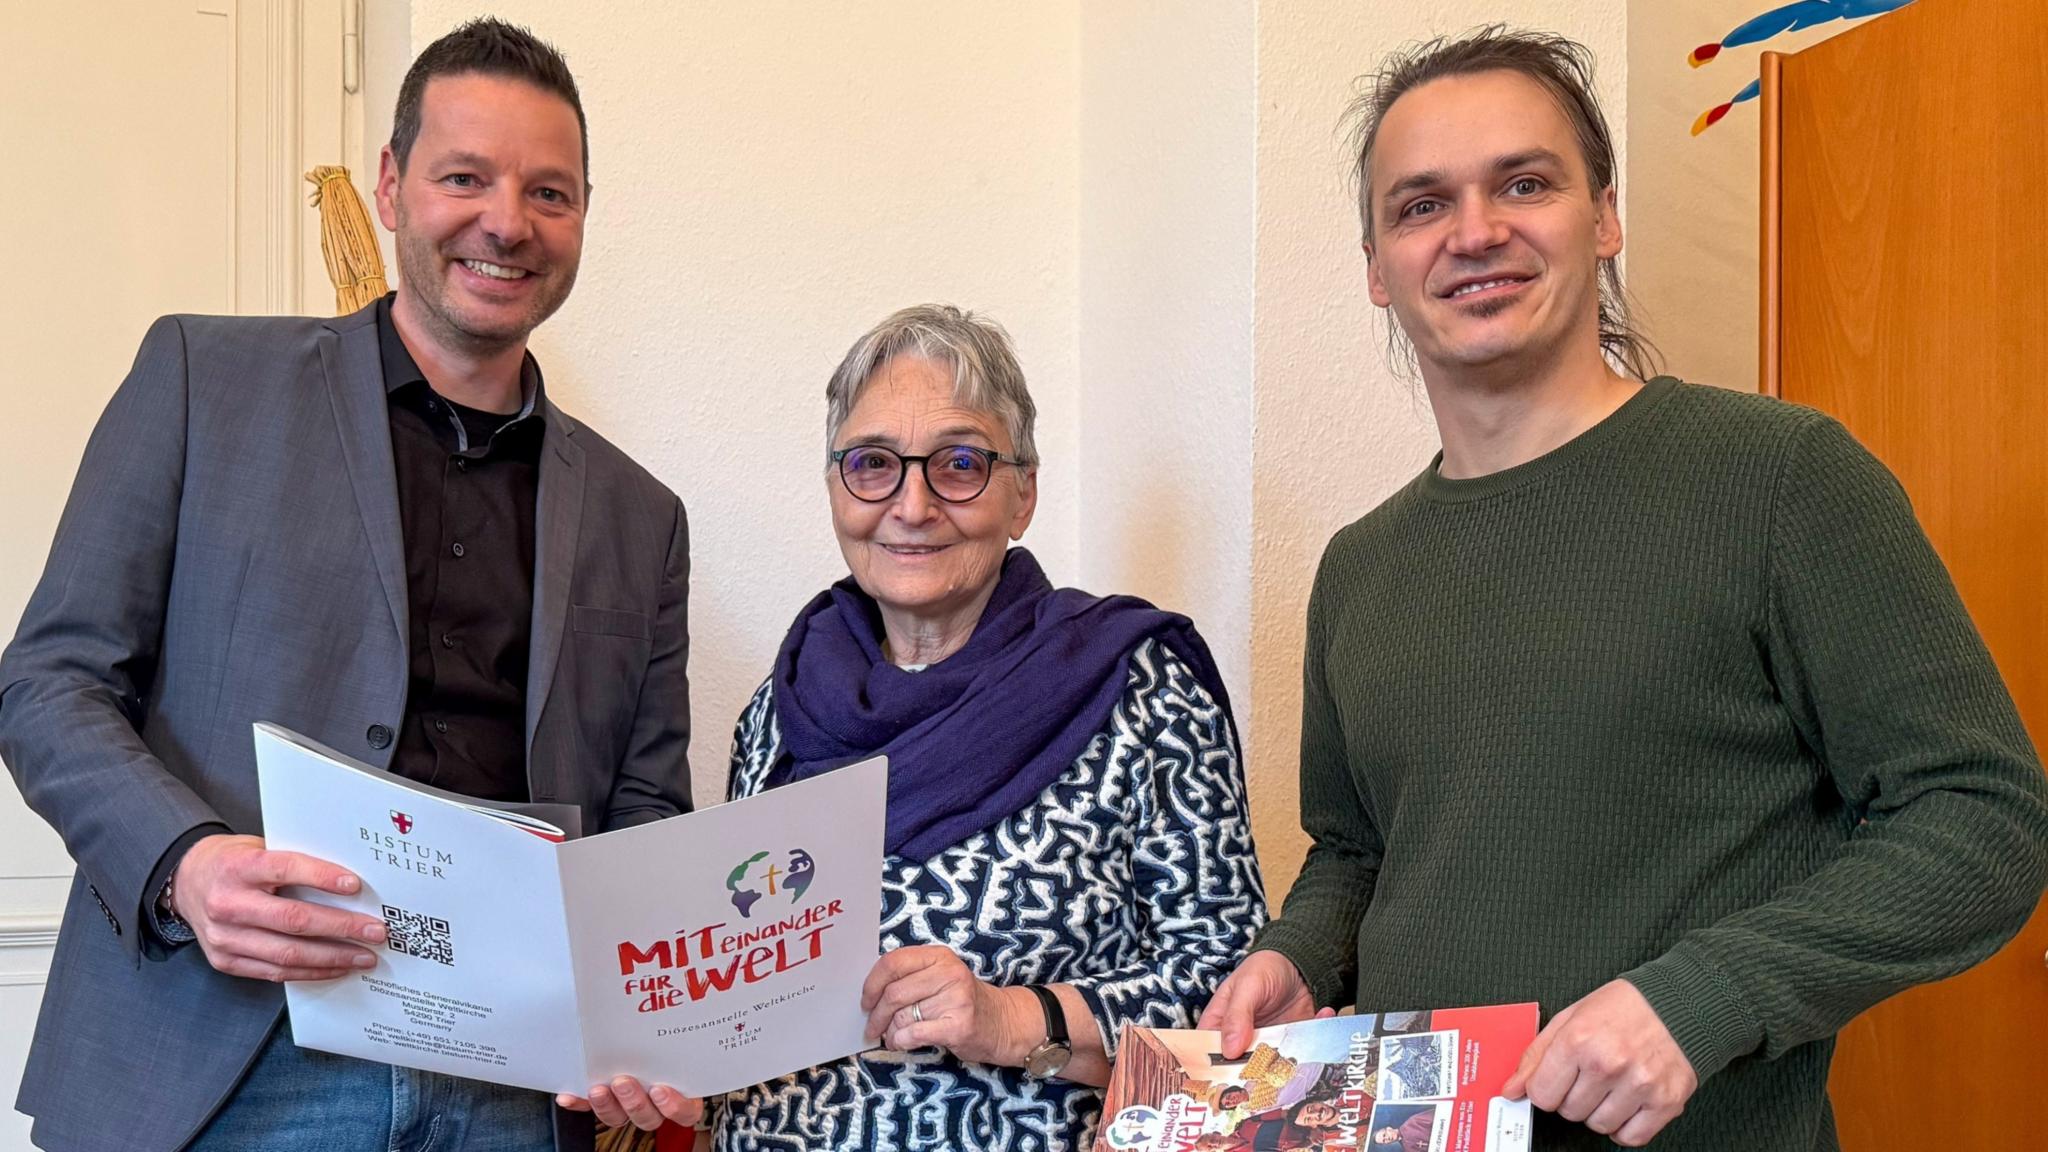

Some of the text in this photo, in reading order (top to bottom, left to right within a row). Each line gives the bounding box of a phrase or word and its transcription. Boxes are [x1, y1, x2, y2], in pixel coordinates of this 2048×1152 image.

[360, 827, 453, 865] BISTUM
[370, 847, 446, 879] TRIER
[370, 985, 487, 1019] Diözesanstelle Weltkirche
[638, 988, 685, 1014] die
[657, 983, 816, 1037] Diözesanstelle Weltkirche
[404, 1008, 456, 1026] 54290 Trier
[410, 1017, 452, 1032] Germany
[364, 1027, 384, 1037] Mail:
[368, 1034, 391, 1044] Web:
[372, 1022, 404, 1034] Phone:
[433, 1036, 451, 1044] 651
[454, 1039, 477, 1049] 7105
[718, 1025, 763, 1046] BISTUM
[724, 1034, 758, 1051] TRIER
